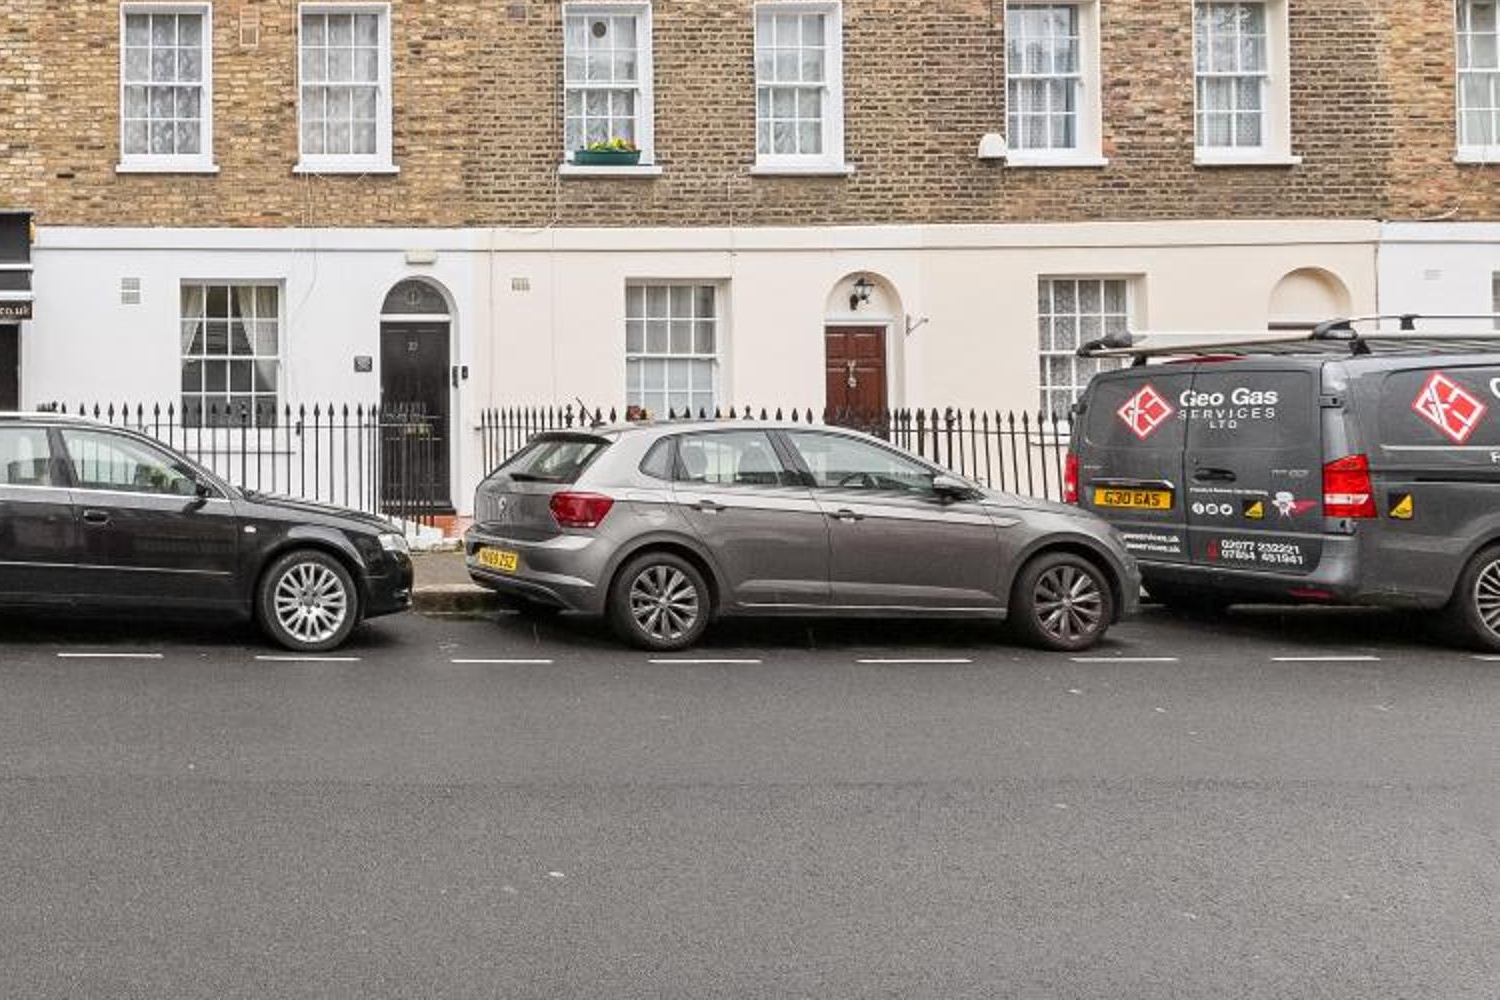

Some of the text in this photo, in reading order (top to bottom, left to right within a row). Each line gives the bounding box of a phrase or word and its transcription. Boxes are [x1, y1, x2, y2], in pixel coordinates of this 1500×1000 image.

[1180, 387, 1279, 407] Geo Gas
[1178, 407, 1275, 419] SERVICES
[1209, 419, 1238, 429] LTD
[1133, 492, 1161, 507] GAS
